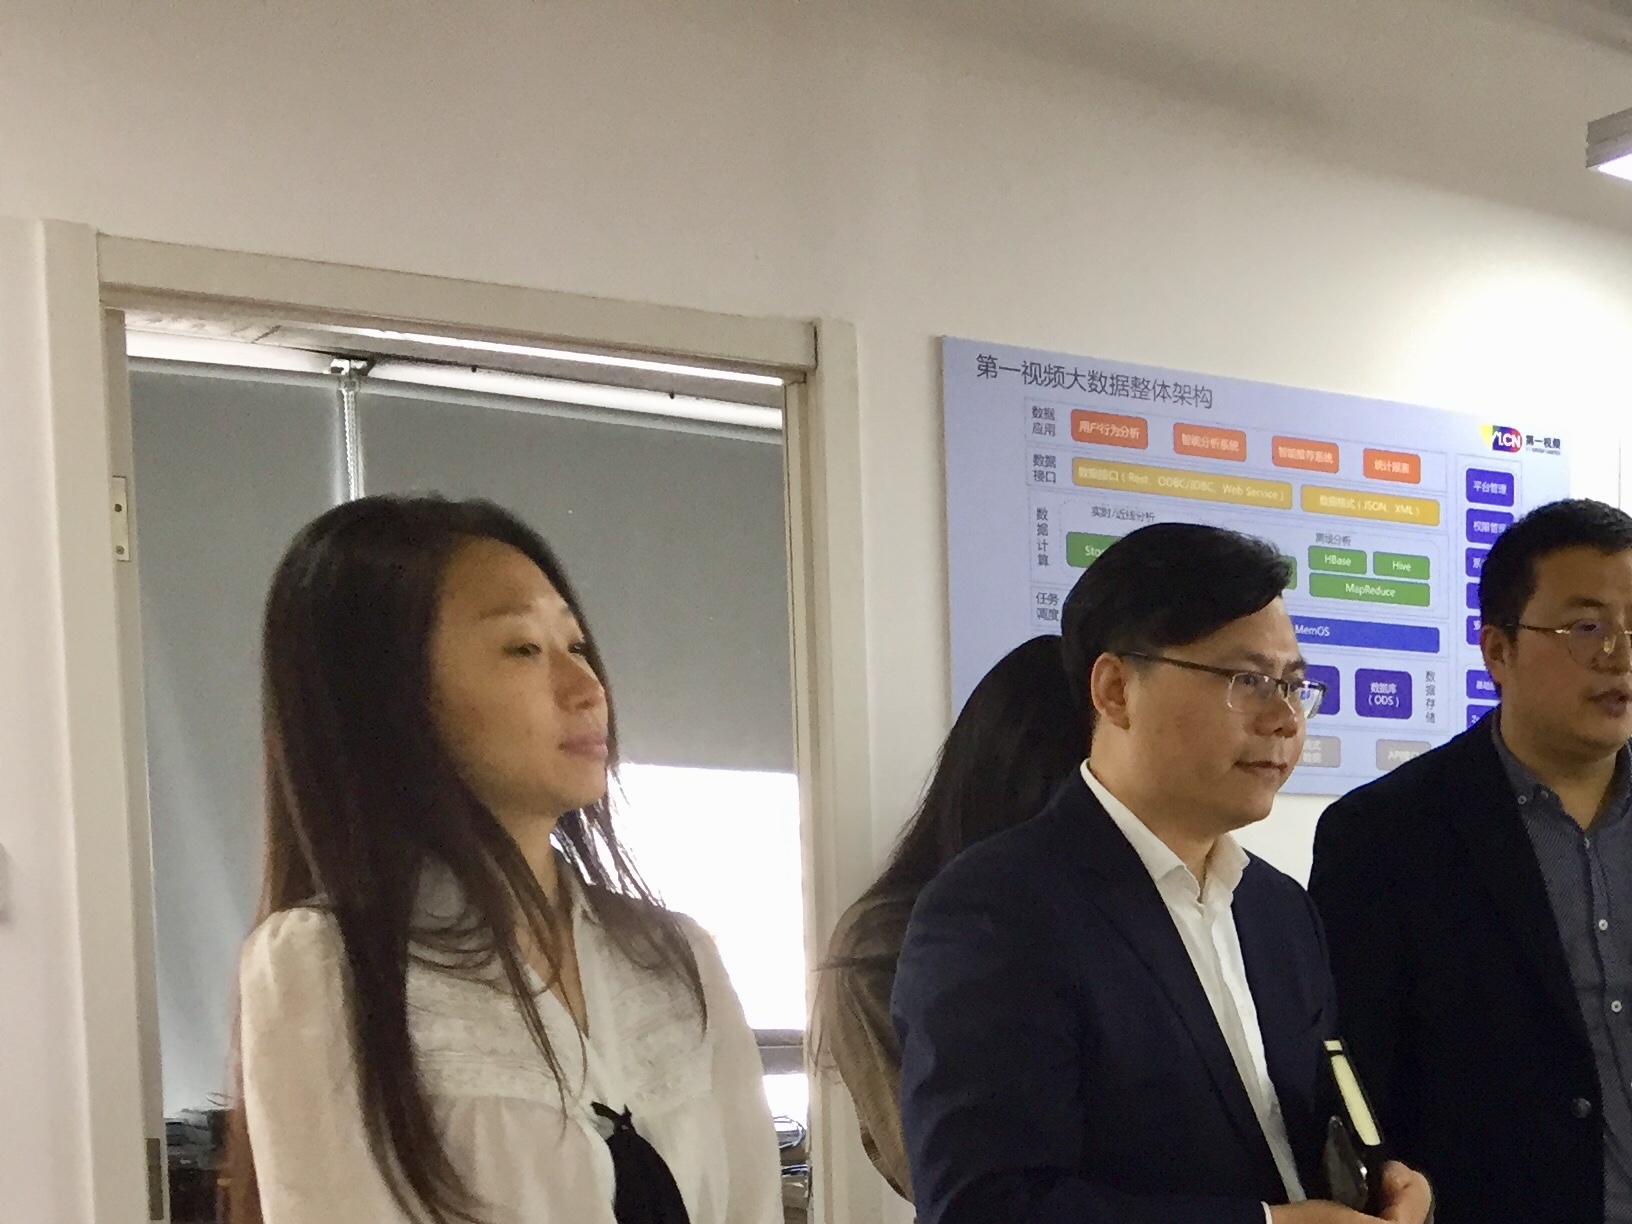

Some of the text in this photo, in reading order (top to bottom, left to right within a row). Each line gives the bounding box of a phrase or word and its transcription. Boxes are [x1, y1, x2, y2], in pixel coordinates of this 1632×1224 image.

[976, 354, 1213, 409] 第一视频大数据整体架构
[1079, 420, 1140, 439] 用户行为分析
[1324, 554, 1352, 567] HBase
[1392, 560, 1412, 572] Hive
[1345, 583, 1396, 598] MapReduce
